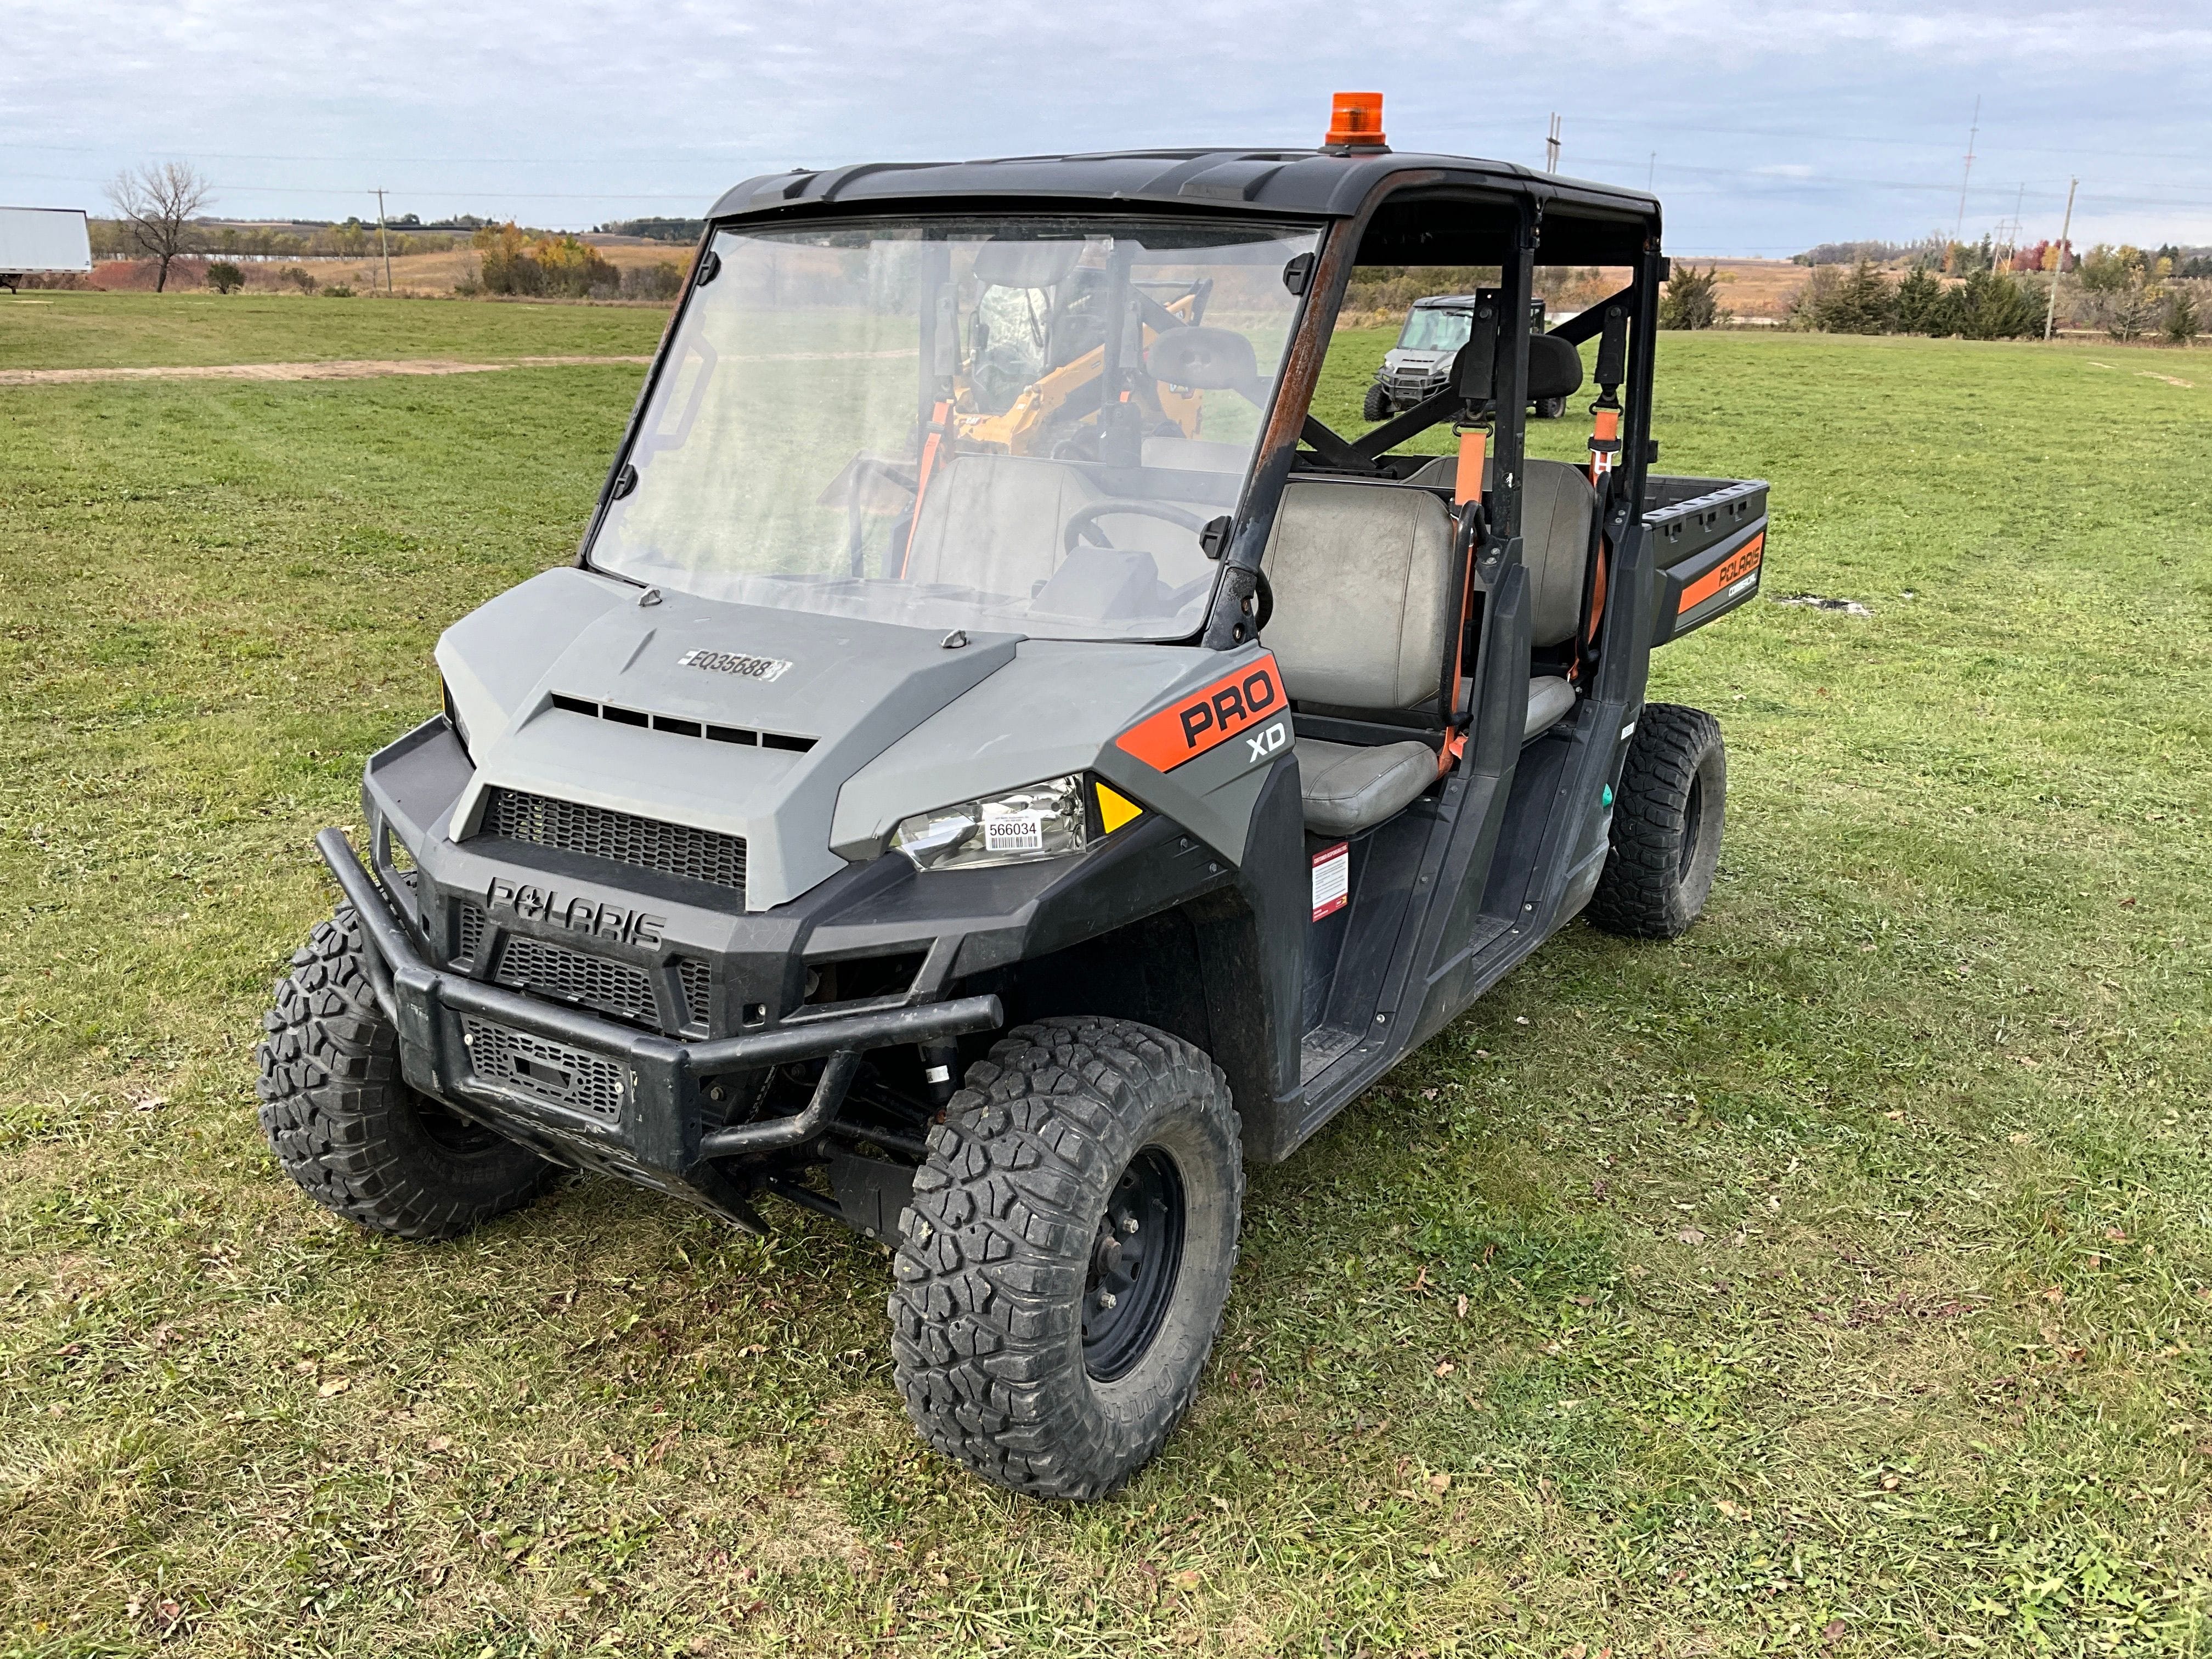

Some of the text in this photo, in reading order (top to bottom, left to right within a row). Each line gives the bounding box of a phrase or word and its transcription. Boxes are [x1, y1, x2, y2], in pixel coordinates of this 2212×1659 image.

[1718, 546, 1760, 586] POLARIS
[687, 651, 772, 676] EQ35688
[1180, 670, 1275, 749] PRO
[1246, 722, 1286, 763] XD
[990, 822, 1036, 836] 566034
[487, 876, 668, 952] POLARIS
